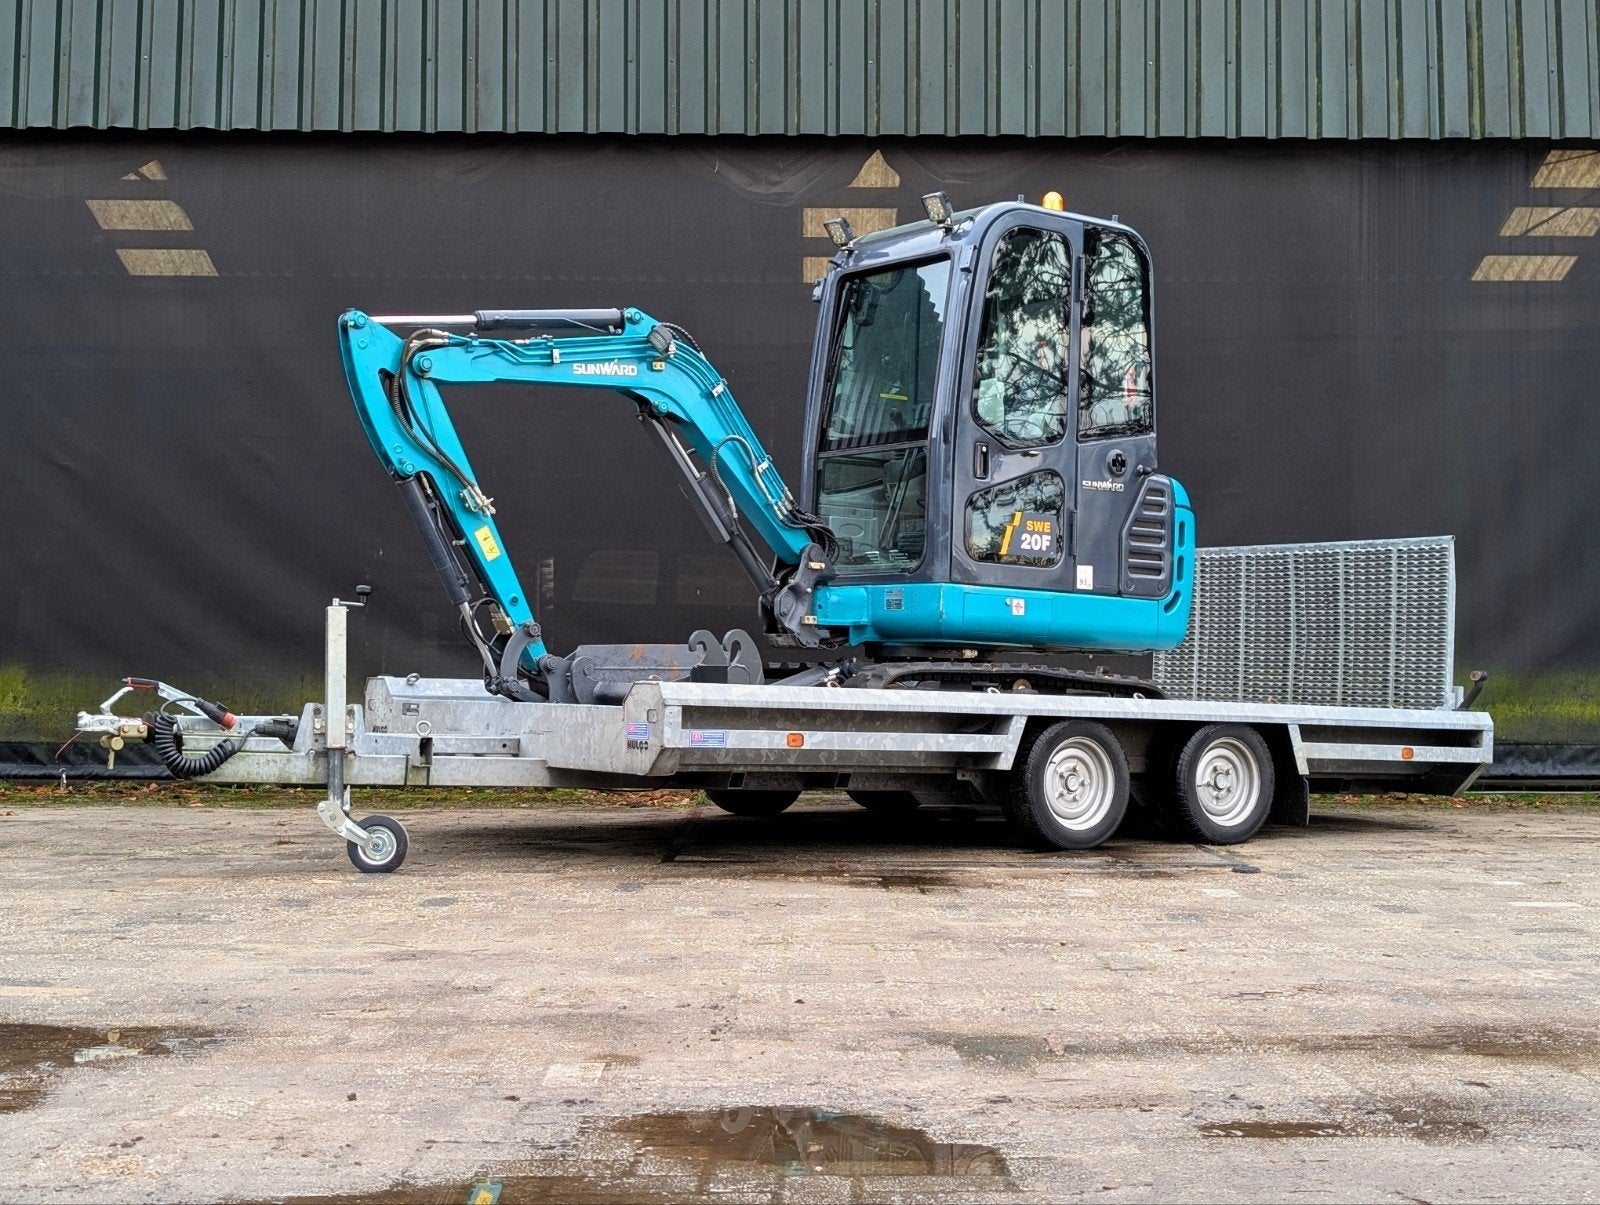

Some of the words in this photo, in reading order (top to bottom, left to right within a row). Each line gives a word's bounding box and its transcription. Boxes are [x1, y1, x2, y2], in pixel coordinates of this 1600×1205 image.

[572, 359, 638, 376] SUNWARD
[1026, 520, 1051, 533] SWE
[1020, 533, 1052, 551] 20F
